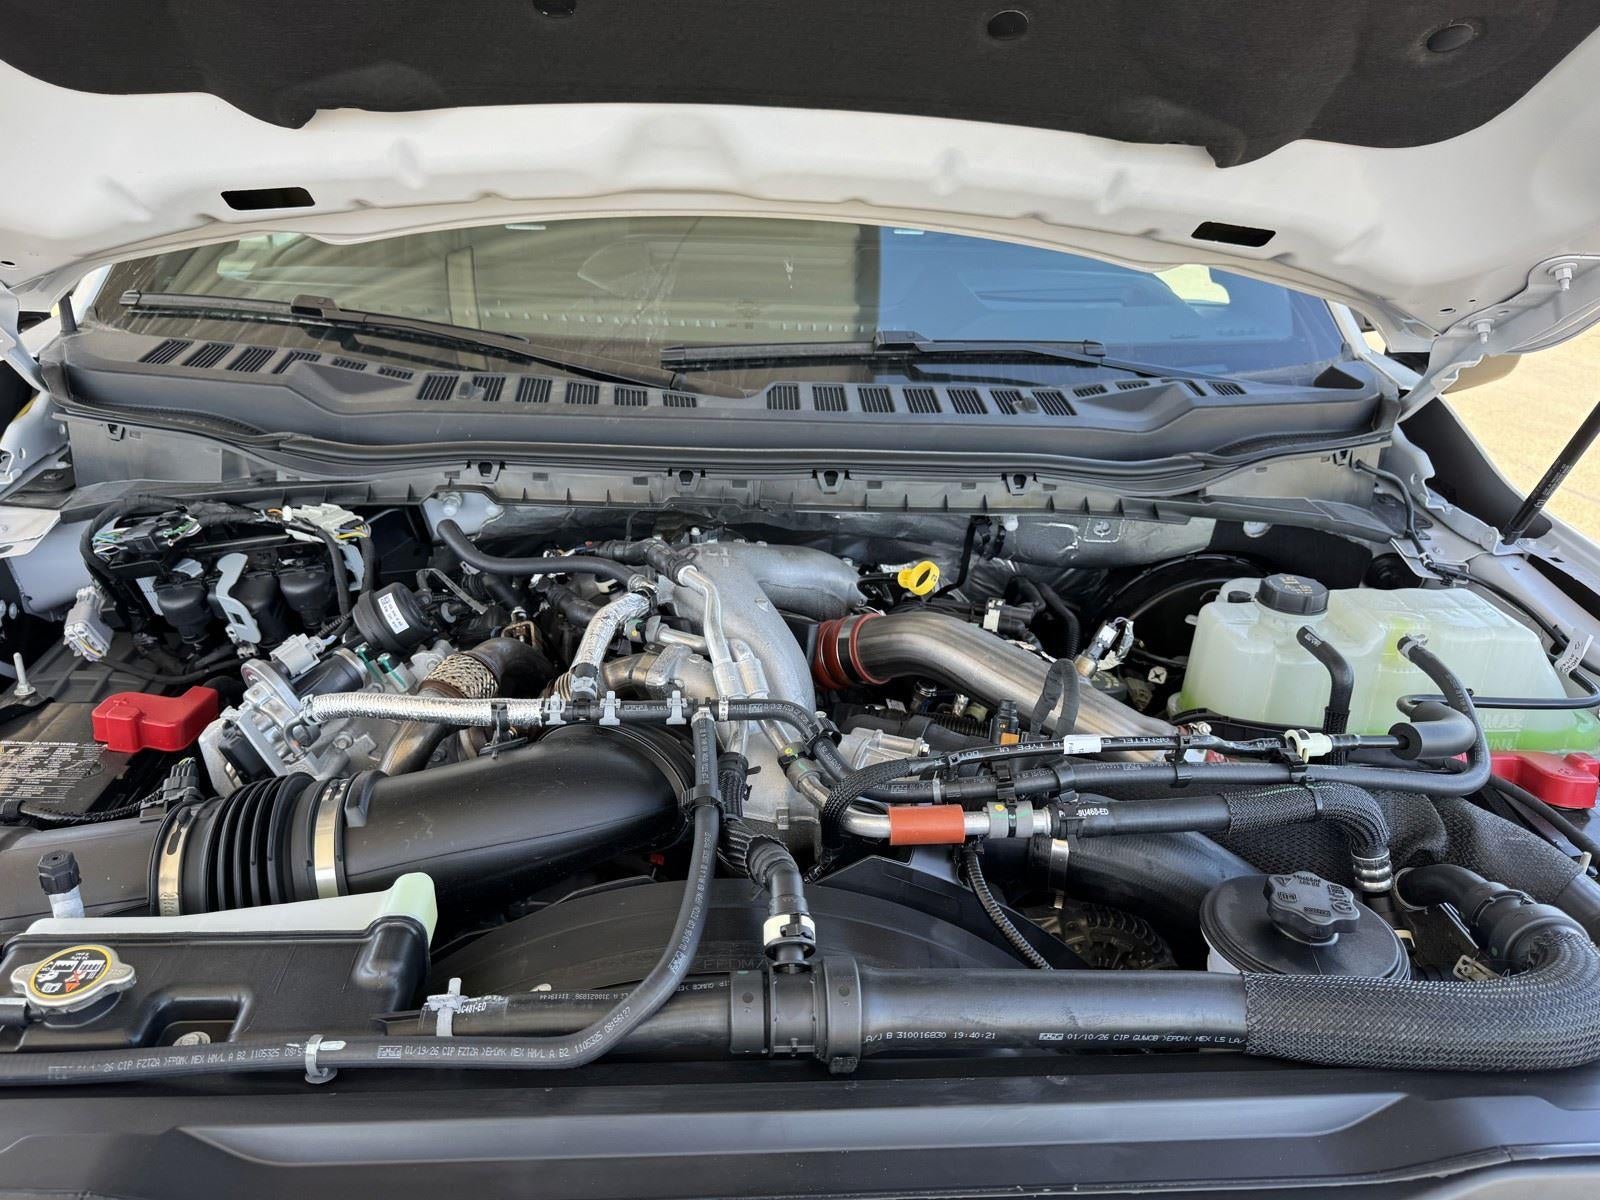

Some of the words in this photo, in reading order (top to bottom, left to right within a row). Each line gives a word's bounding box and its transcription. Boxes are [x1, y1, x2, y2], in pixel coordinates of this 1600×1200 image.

[1017, 743, 1045, 751] TYPE
[896, 1031, 947, 1039] 310016830
[953, 1031, 996, 1040] 19:40:21
[1067, 1033, 1109, 1041] 01/10/26
[441, 1046, 456, 1057] CIP
[549, 1049, 556, 1058] A
